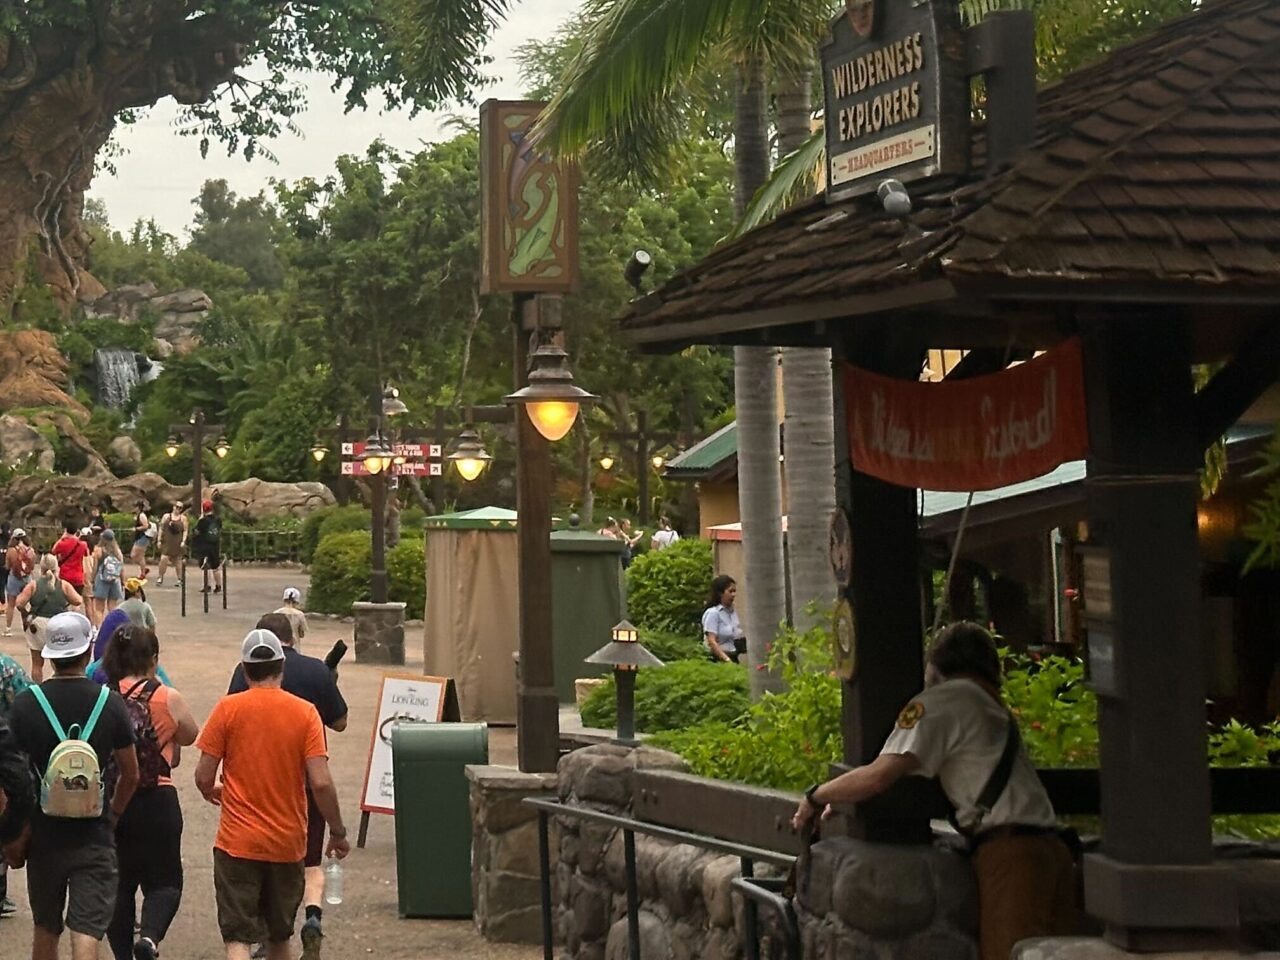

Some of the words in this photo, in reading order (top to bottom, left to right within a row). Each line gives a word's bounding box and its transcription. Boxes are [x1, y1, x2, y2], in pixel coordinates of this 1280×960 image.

[831, 31, 924, 100] WILDERNESS
[838, 81, 920, 142] EXPLORERS
[847, 139, 914, 174] HEADQUARTERS
[391, 694, 409, 705] LION
[409, 696, 429, 707] KING
